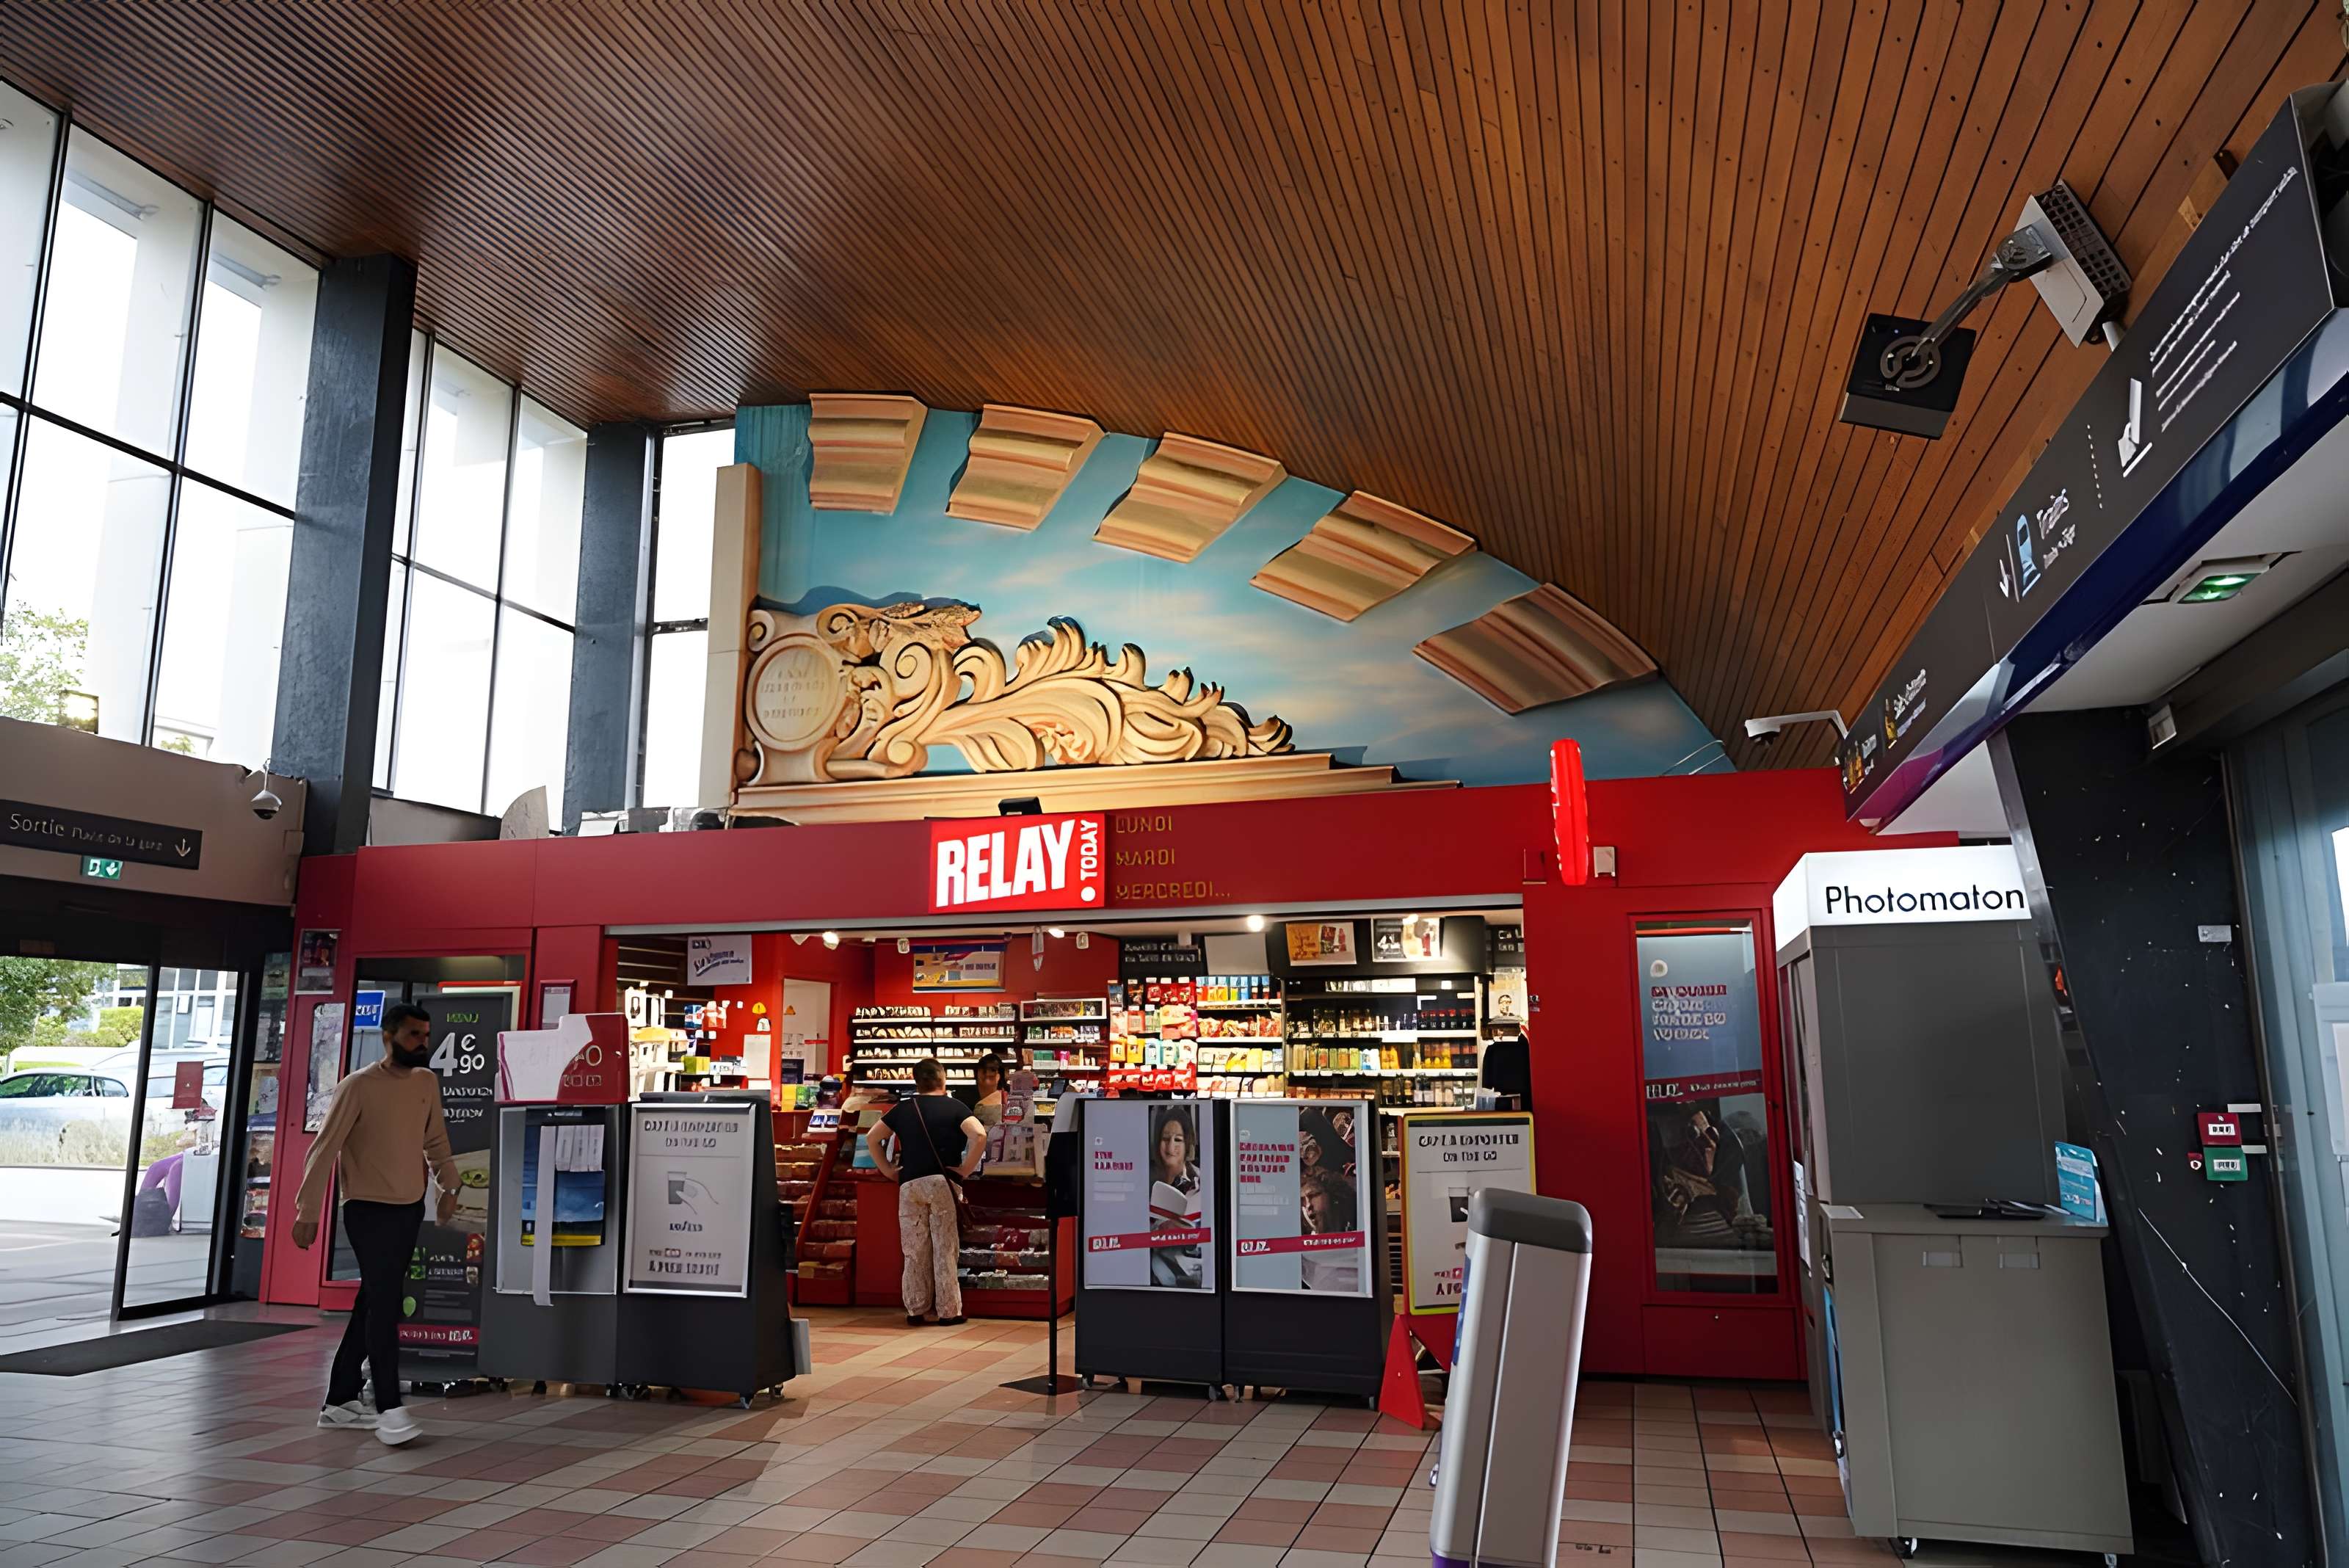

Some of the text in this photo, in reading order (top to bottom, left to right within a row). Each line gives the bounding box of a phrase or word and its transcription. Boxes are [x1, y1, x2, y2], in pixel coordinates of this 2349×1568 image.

[10, 813, 65, 837] Sortie
[1116, 816, 1172, 833] LUNDI
[936, 819, 1075, 907] RELAY
[1080, 819, 1098, 881] TODAY
[1826, 884, 2025, 913] Photomaton
